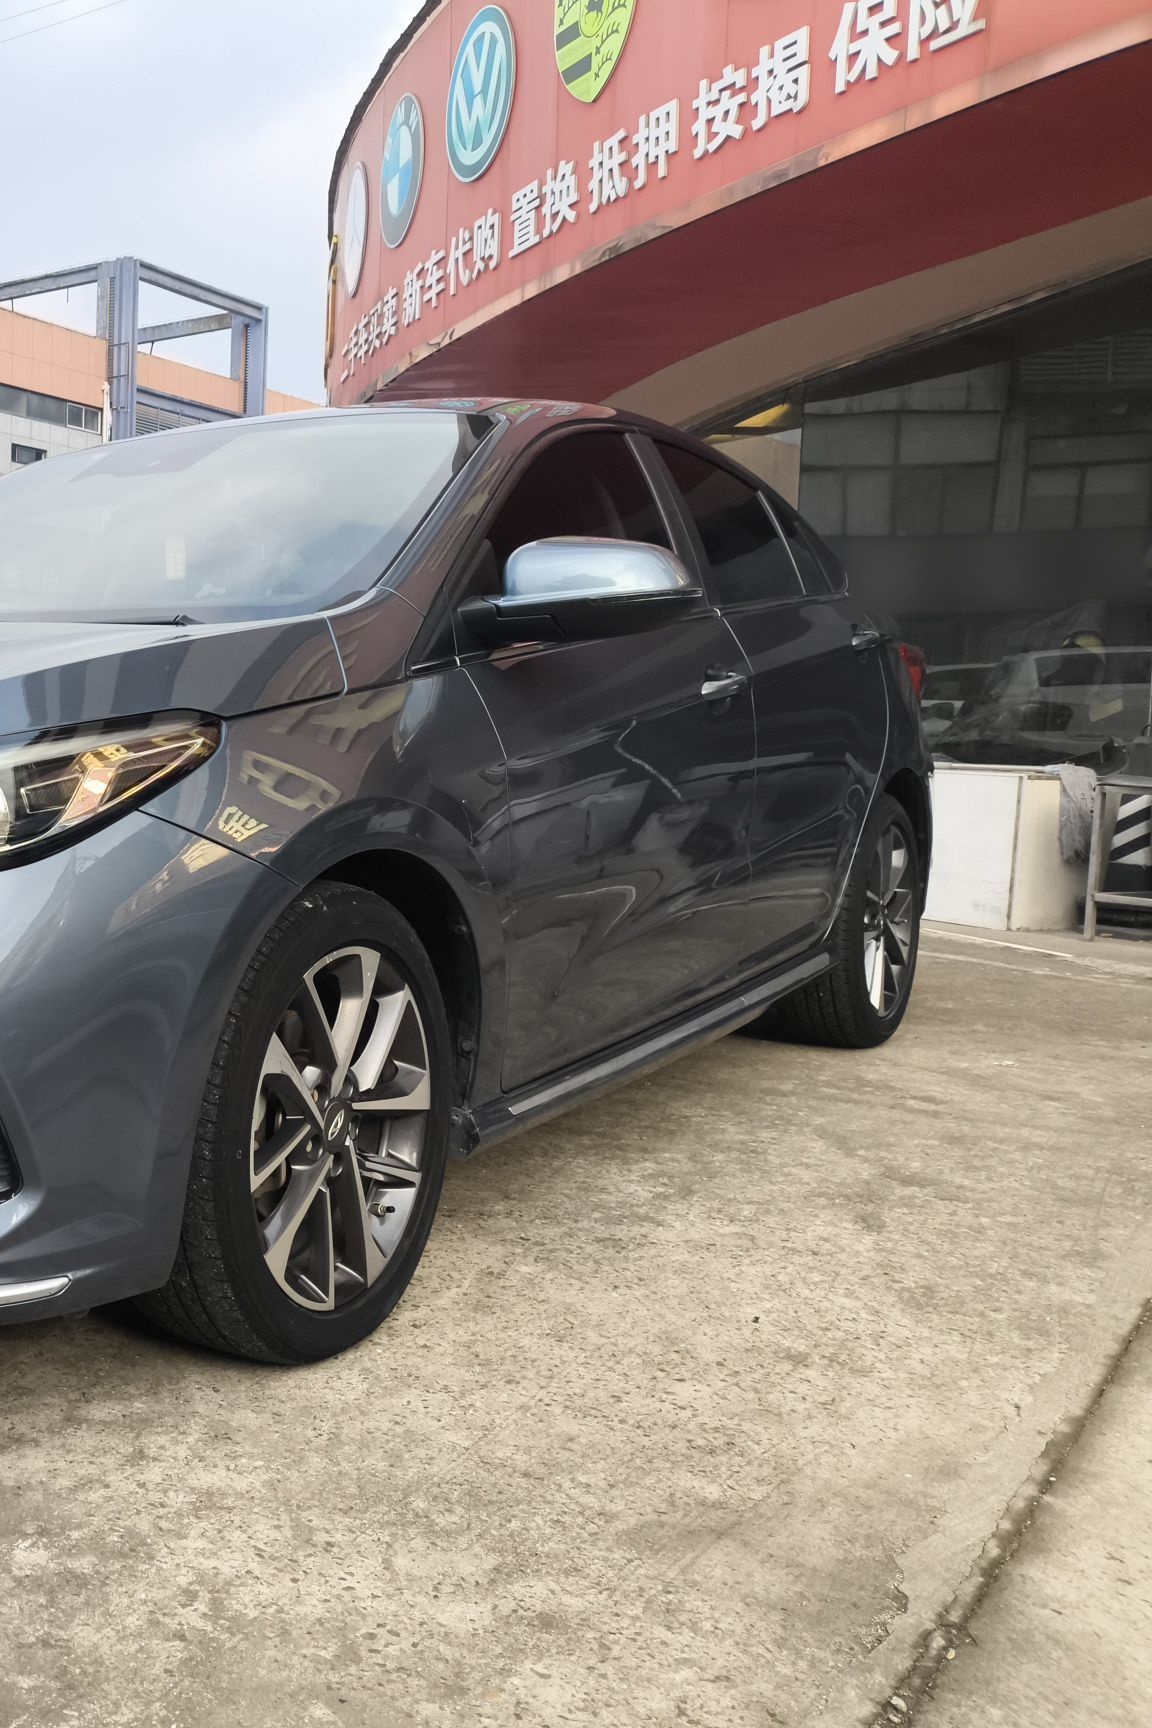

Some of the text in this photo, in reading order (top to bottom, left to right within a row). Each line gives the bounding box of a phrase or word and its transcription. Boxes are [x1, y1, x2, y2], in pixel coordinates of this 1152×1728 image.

[340, 0, 986, 383] 二手车买卖 新车代购 置换 抵押 按揭 保险
